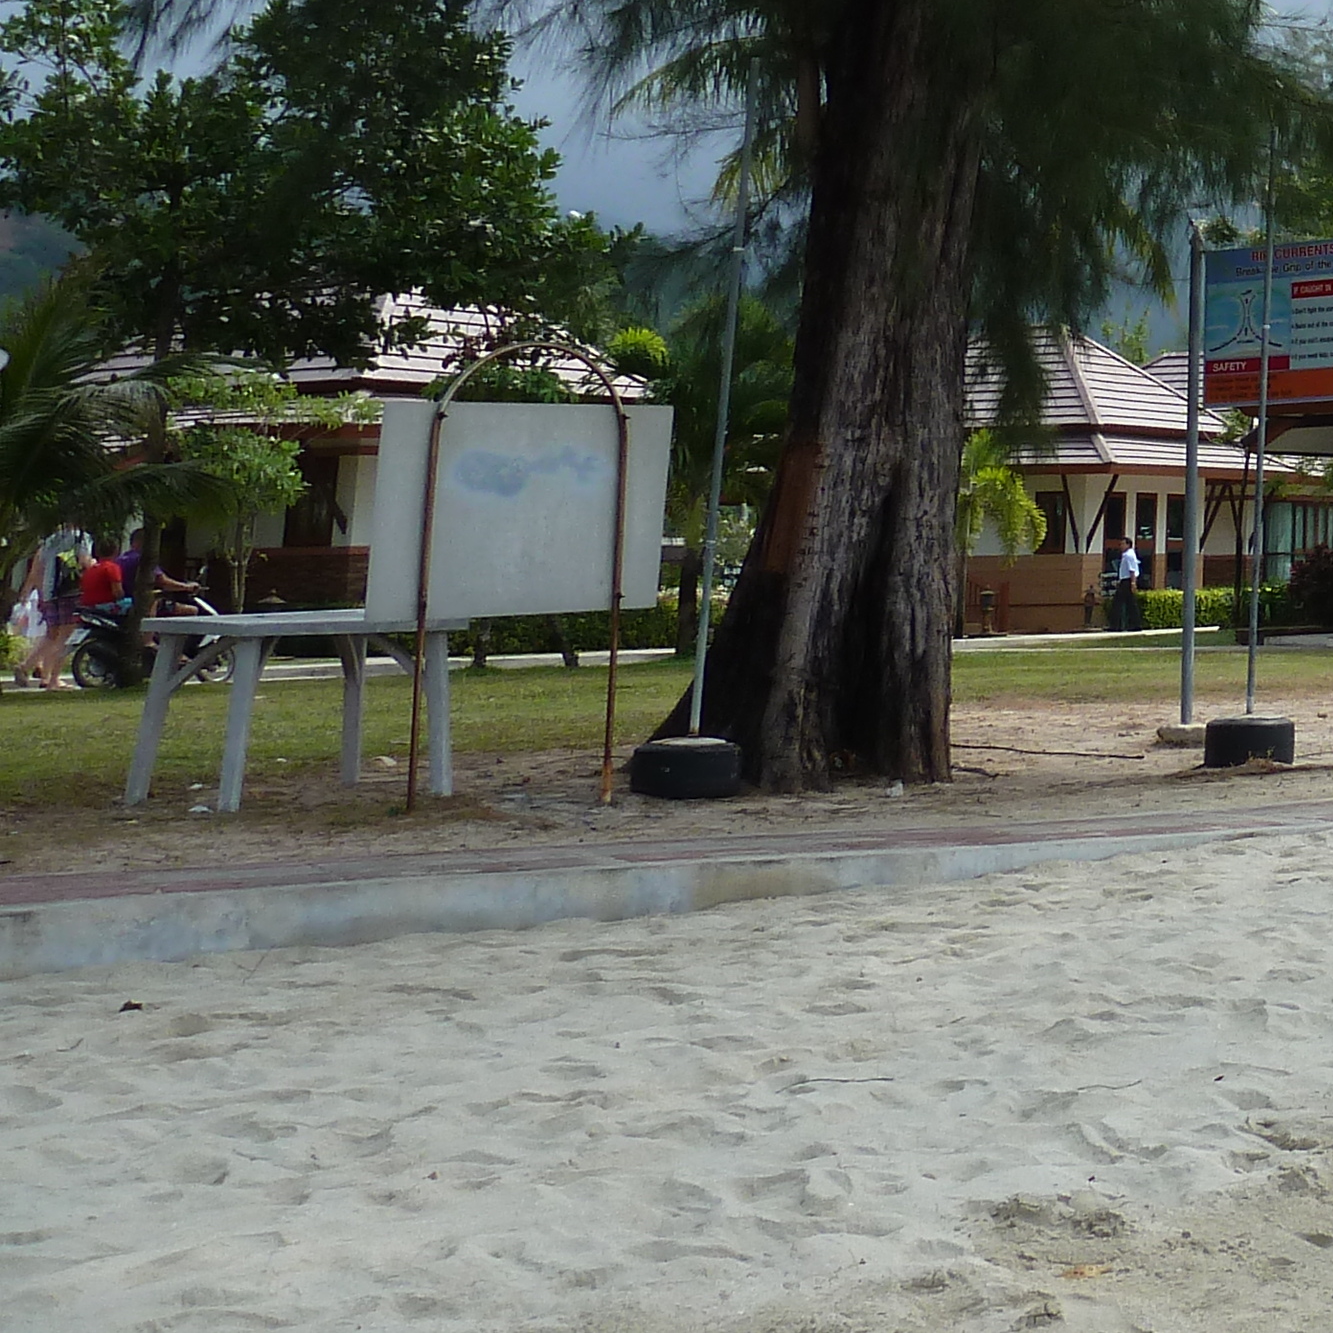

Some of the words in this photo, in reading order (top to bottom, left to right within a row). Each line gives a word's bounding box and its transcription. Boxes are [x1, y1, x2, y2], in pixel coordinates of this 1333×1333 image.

[1283, 262, 1301, 273] Grip
[1306, 261, 1314, 270] of
[1318, 259, 1332, 269] the
[1212, 361, 1247, 372] SAFETY
